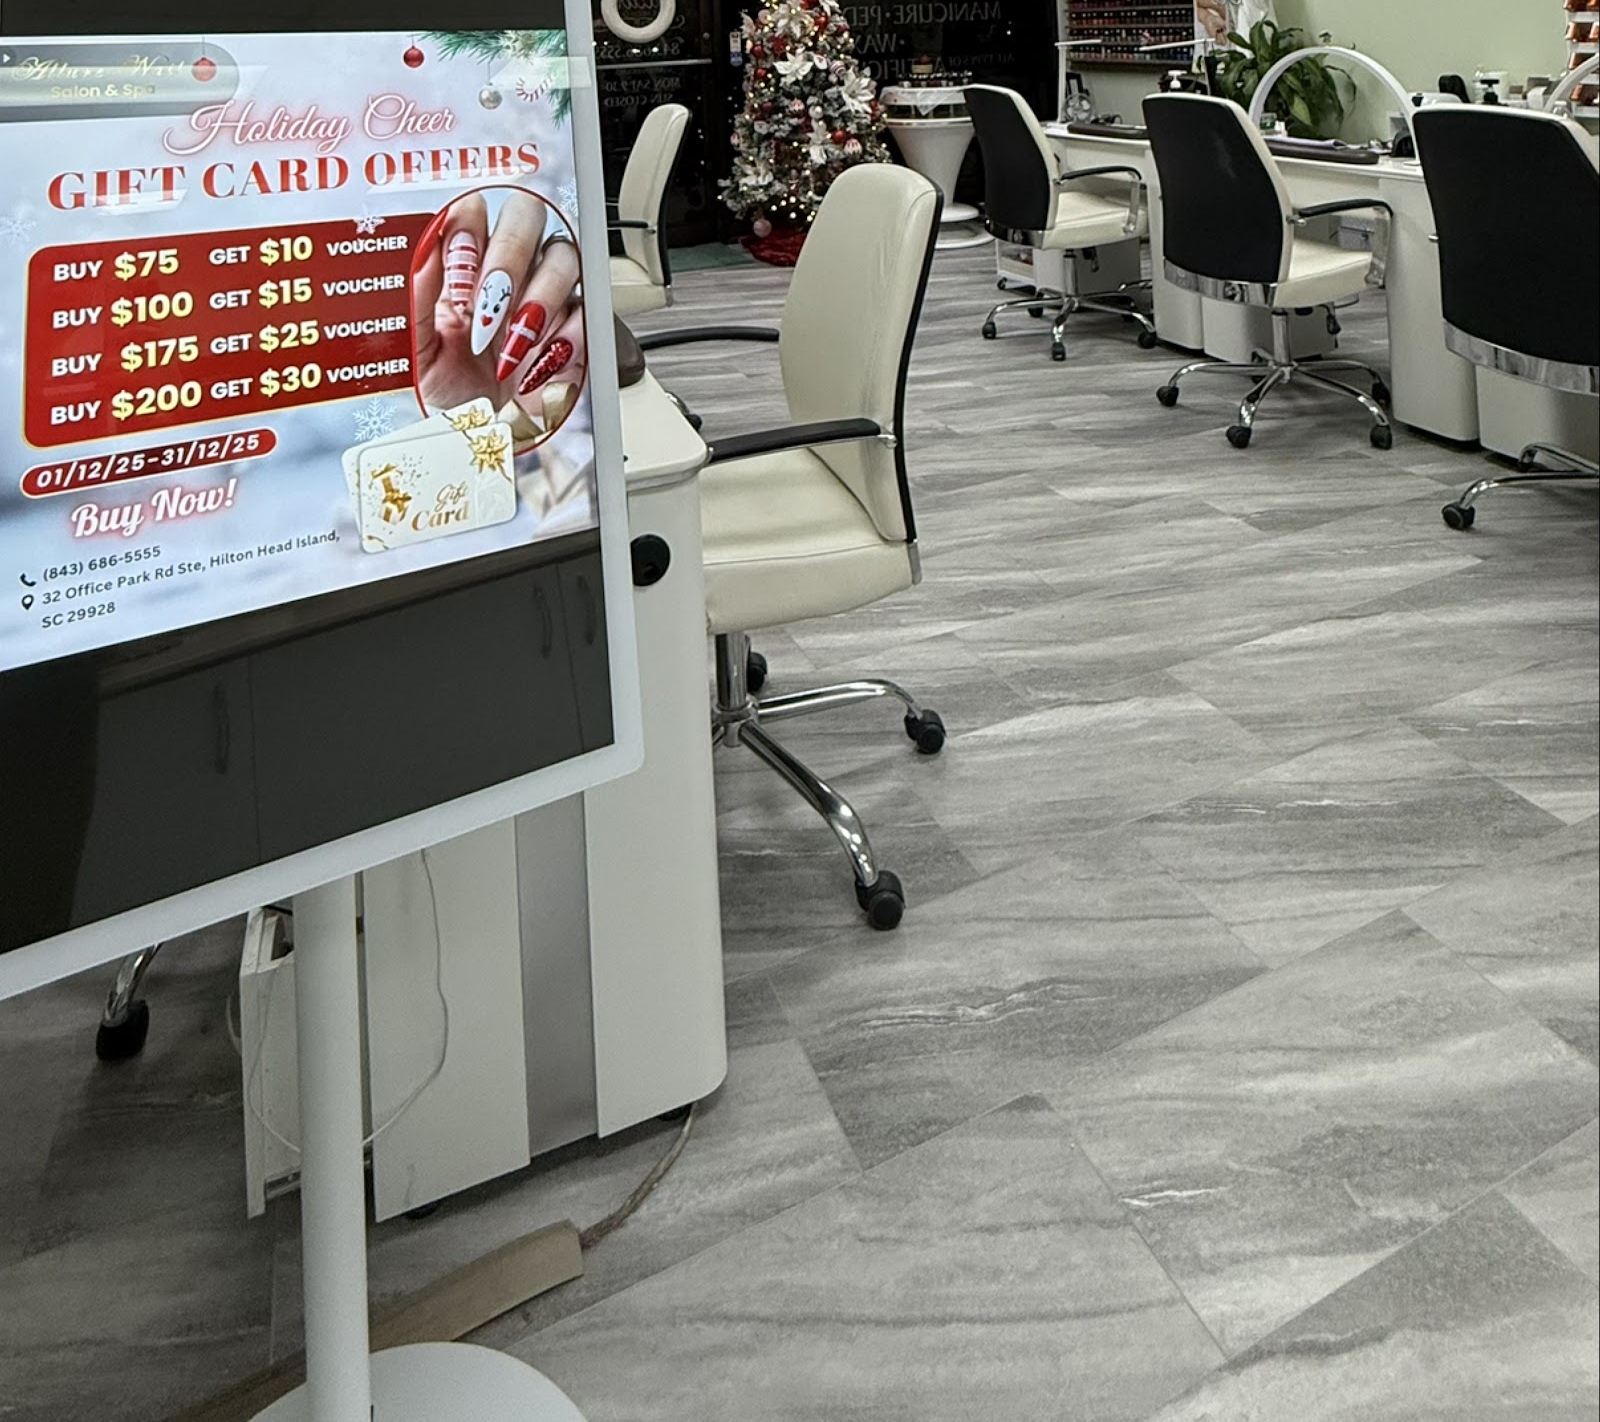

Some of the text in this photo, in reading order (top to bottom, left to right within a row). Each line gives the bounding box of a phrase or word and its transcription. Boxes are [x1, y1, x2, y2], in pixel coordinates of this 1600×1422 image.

[50, 84, 155, 99] Salon & Spa
[163, 94, 457, 155] Holiday Cheer
[47, 142, 541, 211] GIFT CARD OFFERS
[53, 235, 408, 282] BUY $75 GET $10 VOUCHER
[52, 274, 405, 329] BUY $100 GET $15 VOUCHER
[51, 316, 406, 377] BUY $175 GET $25 VOUCHER
[50, 358, 410, 425] BUY $200 GET $30 VOUCHER
[35, 433, 260, 488] 01/12/25-31/12/25
[70, 478, 238, 538] Buy Now!
[411, 500, 470, 531] Card
[434, 480, 470, 513] Gift
[42, 529, 341, 605] 32 Office Park Rd Ste, Hilton Head Island,
[43, 545, 162, 582] (843) 686-5555
[42, 602, 117, 629] SC 29928
